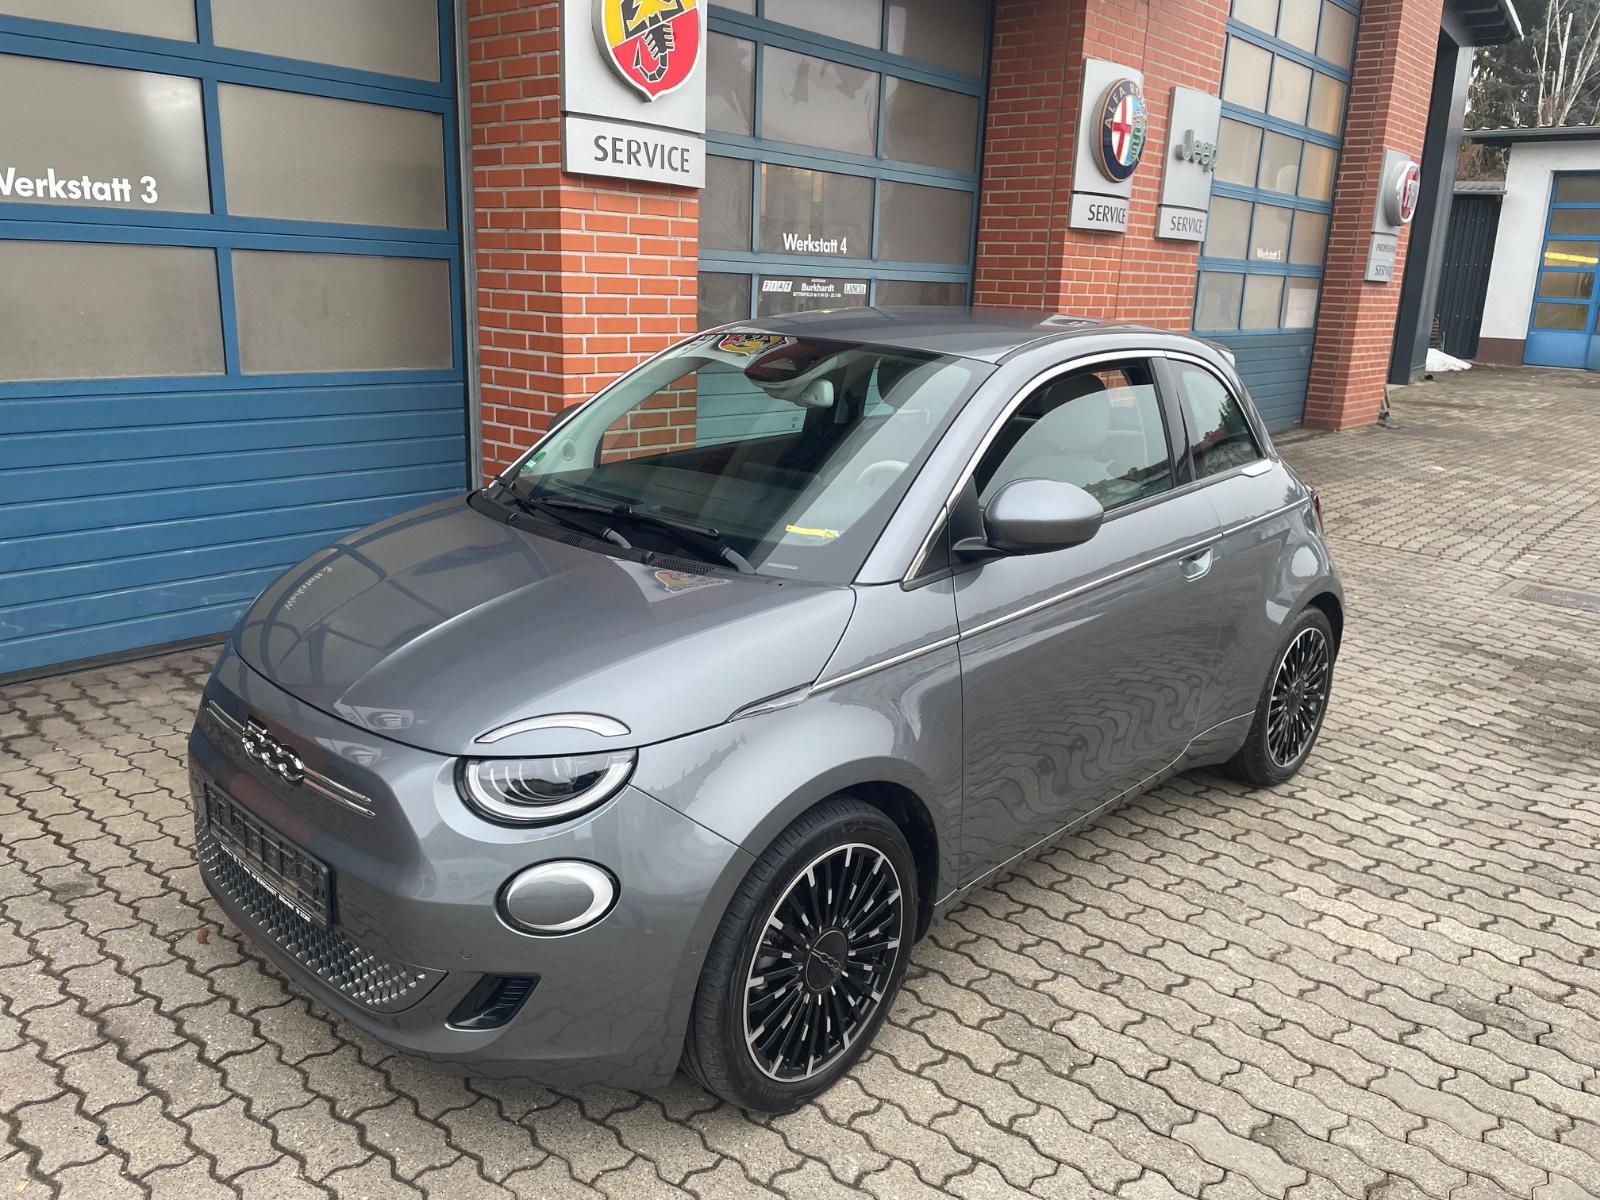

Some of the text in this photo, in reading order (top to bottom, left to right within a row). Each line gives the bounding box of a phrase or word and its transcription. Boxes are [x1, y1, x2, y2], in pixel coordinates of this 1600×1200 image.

[1104, 86, 1127, 130] ALFA
[593, 134, 690, 173] SERVICE
[140, 175, 158, 204] 3
[1087, 203, 1126, 225] SERVICE
[1170, 215, 1204, 235] SERVICE
[783, 232, 847, 254] Werkstatt 4
[762, 281, 793, 292] FIAT
[801, 283, 835, 292] Burkhardt
